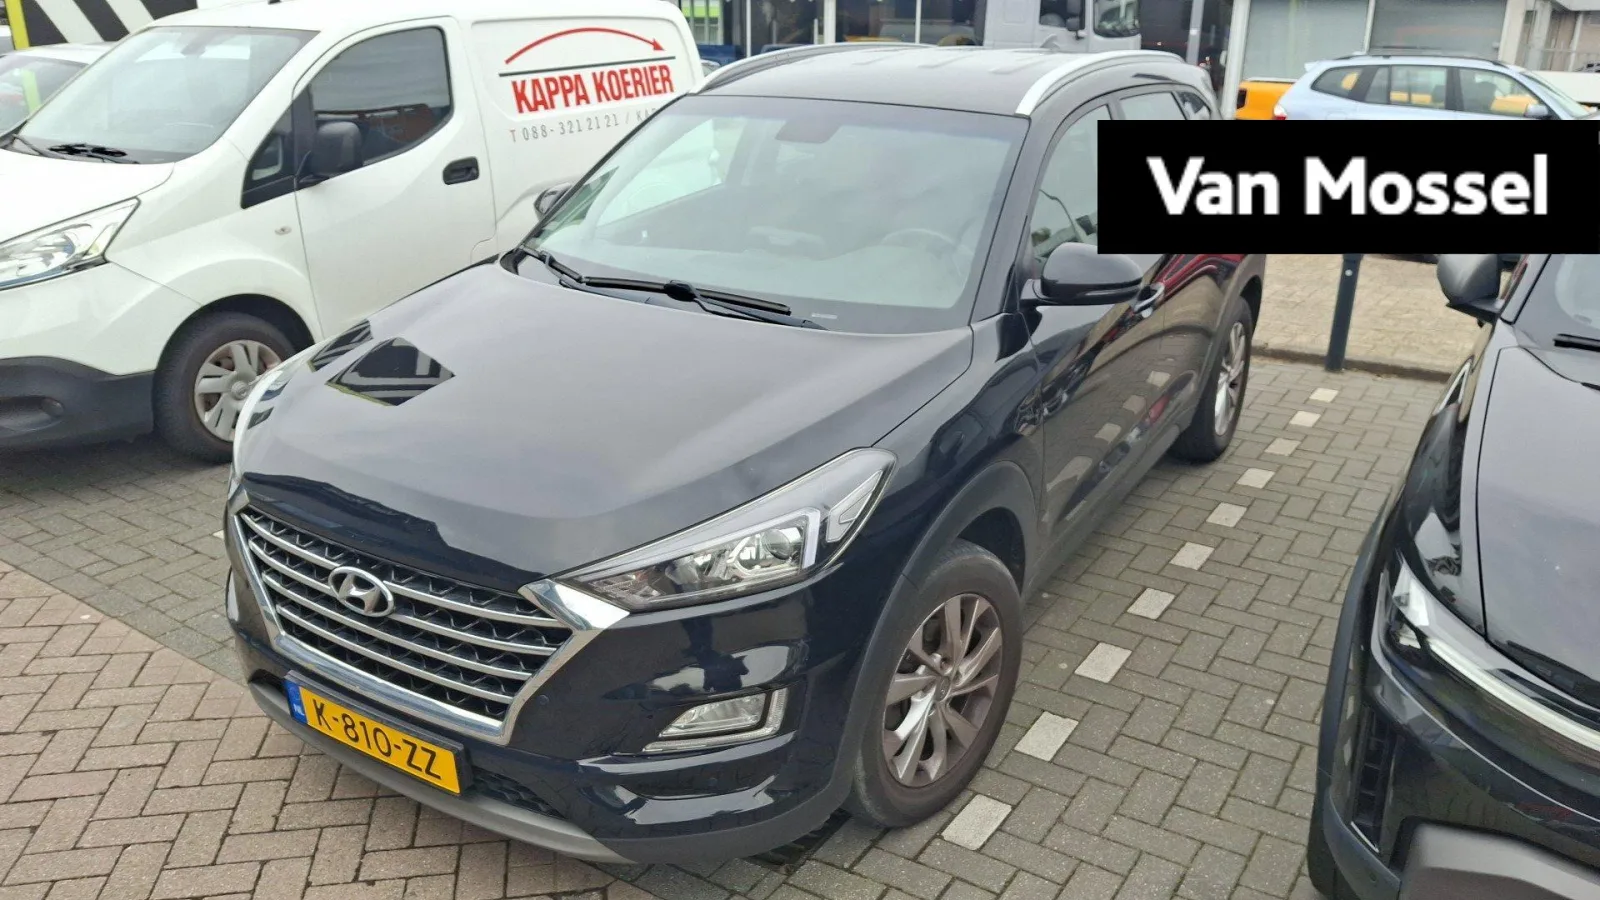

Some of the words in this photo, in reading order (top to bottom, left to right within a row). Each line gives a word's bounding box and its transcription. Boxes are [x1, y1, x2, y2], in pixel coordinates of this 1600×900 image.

[511, 74, 590, 114] KAPPA
[592, 64, 674, 103] KOERIER
[510, 129, 517, 143] T
[312, 698, 442, 780] K-810-ZZ
